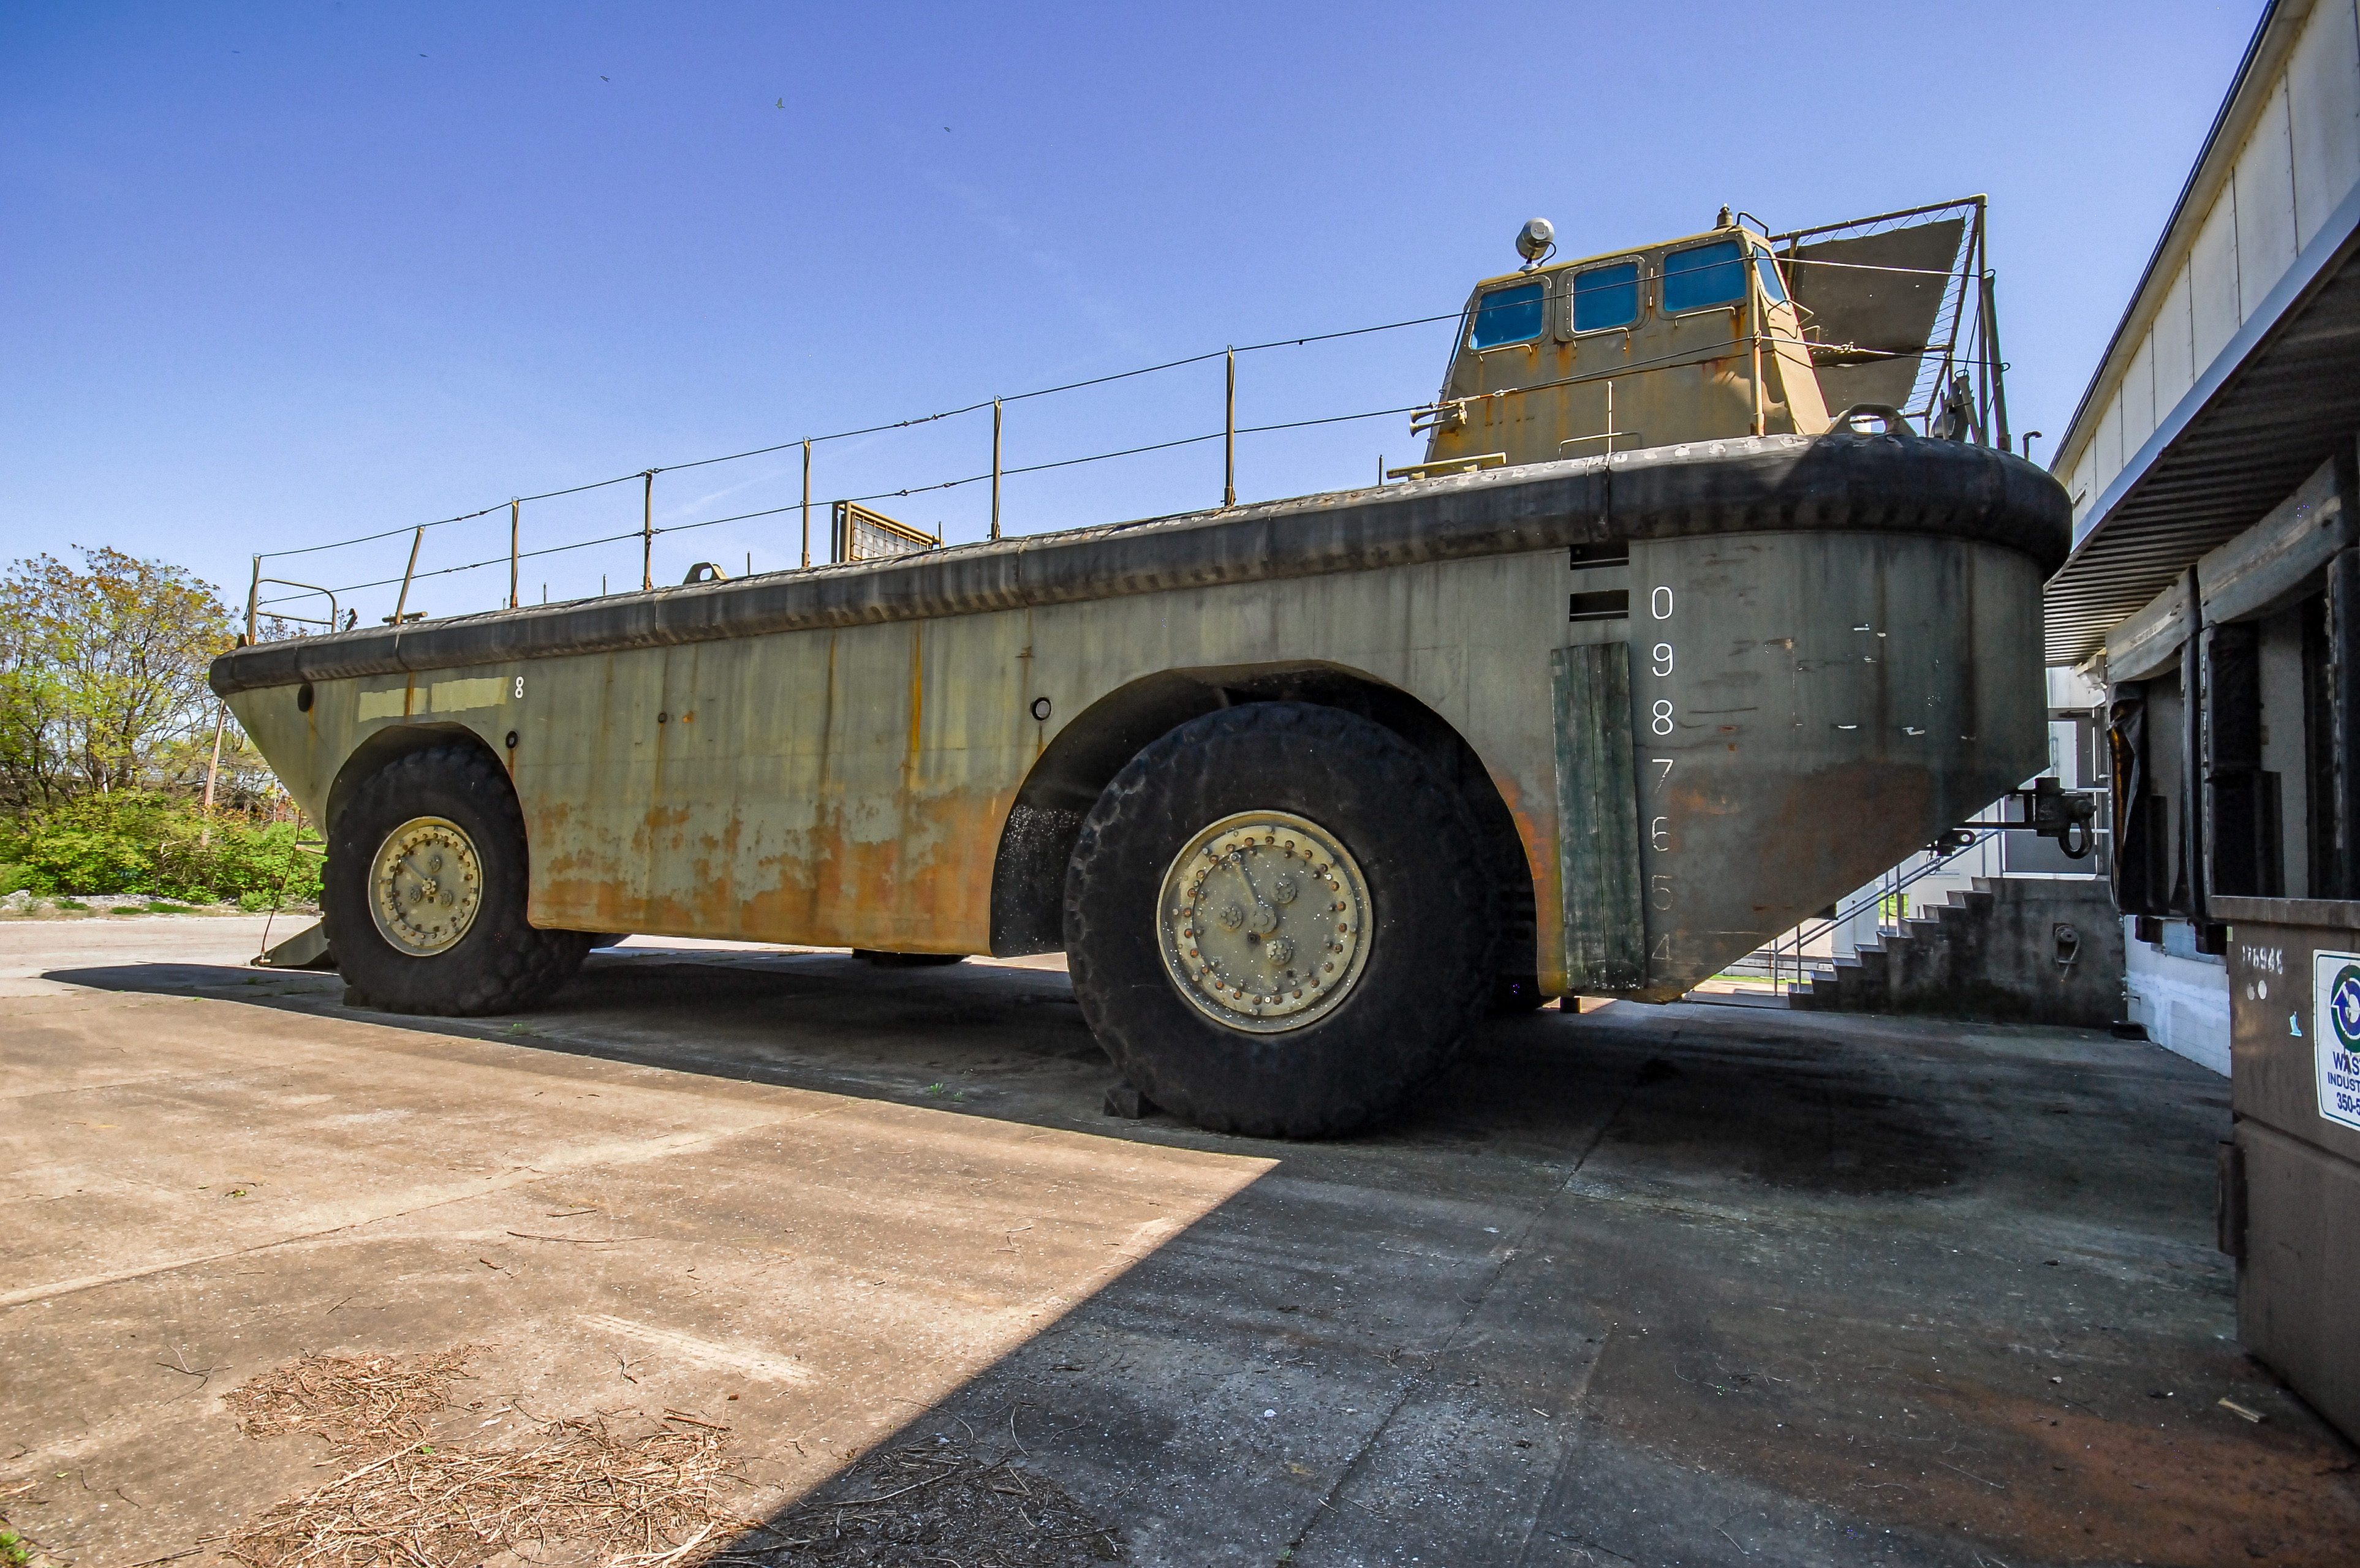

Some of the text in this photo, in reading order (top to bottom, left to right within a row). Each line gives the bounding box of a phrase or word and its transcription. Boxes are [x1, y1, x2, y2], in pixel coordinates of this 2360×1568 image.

[1651, 586, 1674, 620] 0
[1652, 643, 1674, 677] 9
[514, 676, 524, 699] 8
[1652, 699, 1674, 735] 8
[1652, 758, 1674, 794] 7
[1651, 816, 1673, 852] 6
[1651, 875, 1673, 911] 5
[1651, 933, 1673, 968] 4
[2332, 1051, 2360, 1076] WAS
